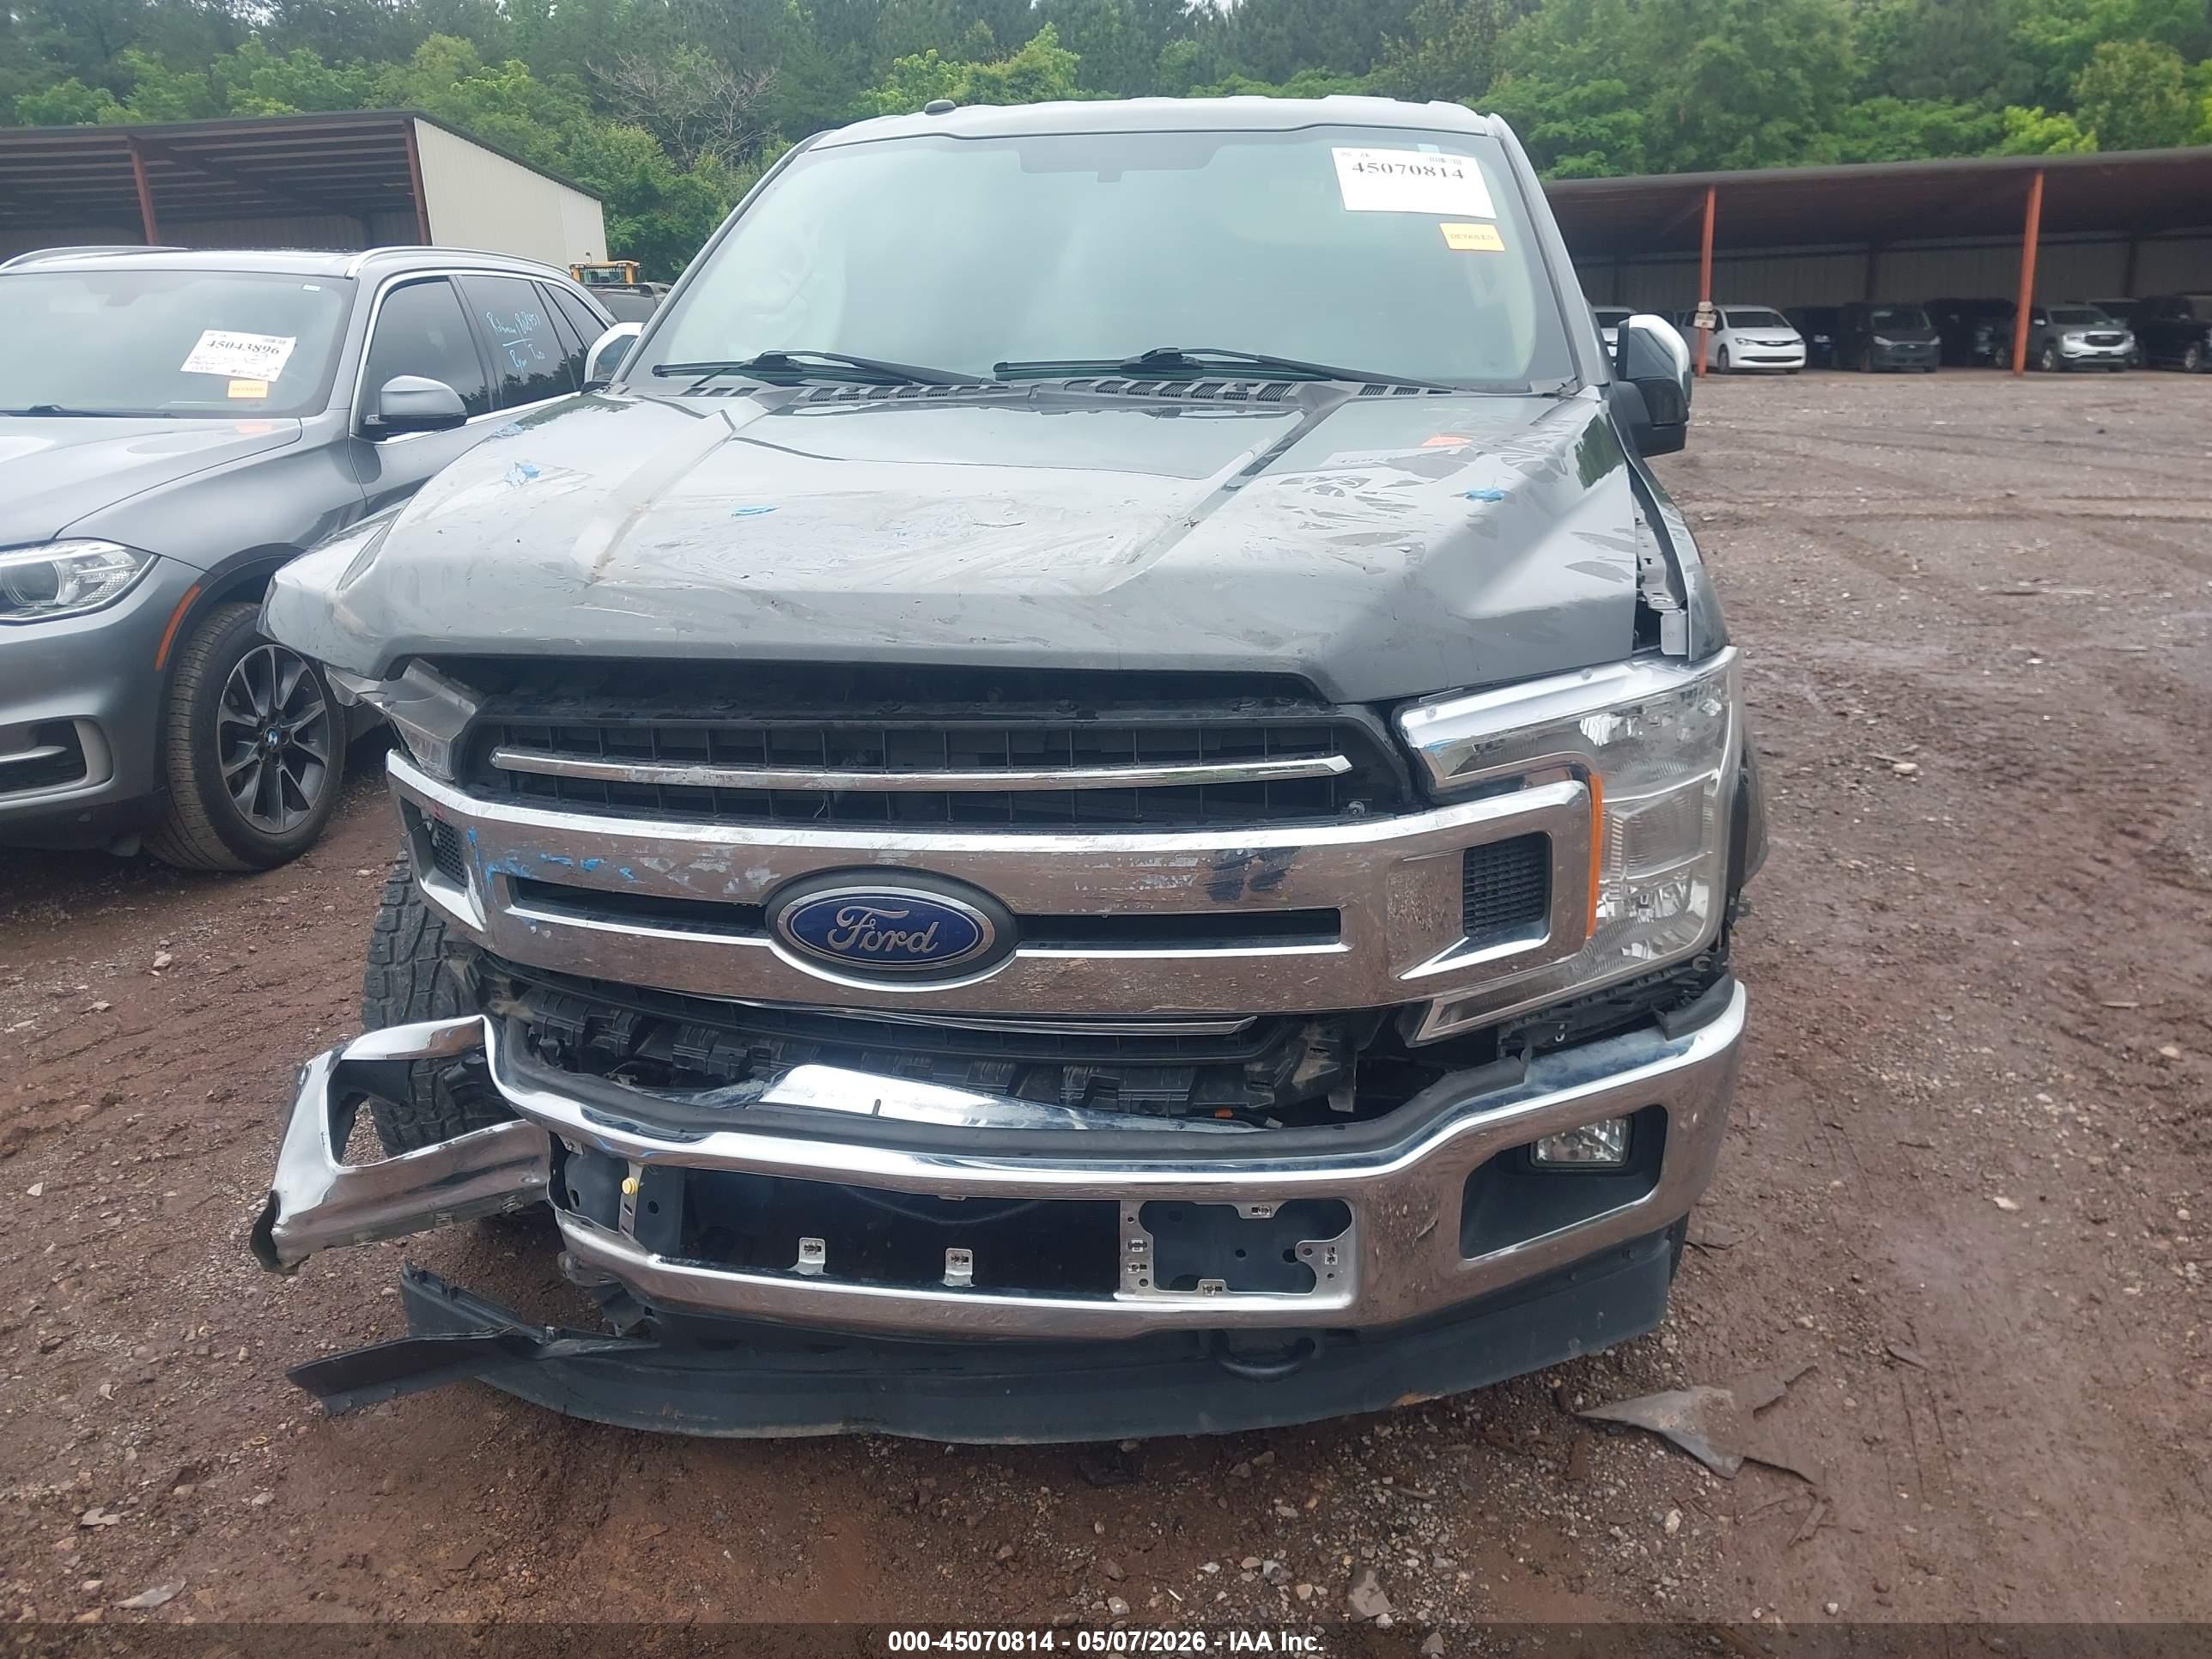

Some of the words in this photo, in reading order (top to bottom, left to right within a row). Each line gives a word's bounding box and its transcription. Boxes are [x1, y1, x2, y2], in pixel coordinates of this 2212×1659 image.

[1351, 161, 1465, 179] 45070814
[206, 339, 280, 356] 45043896
[827, 906, 939, 953] Ford
